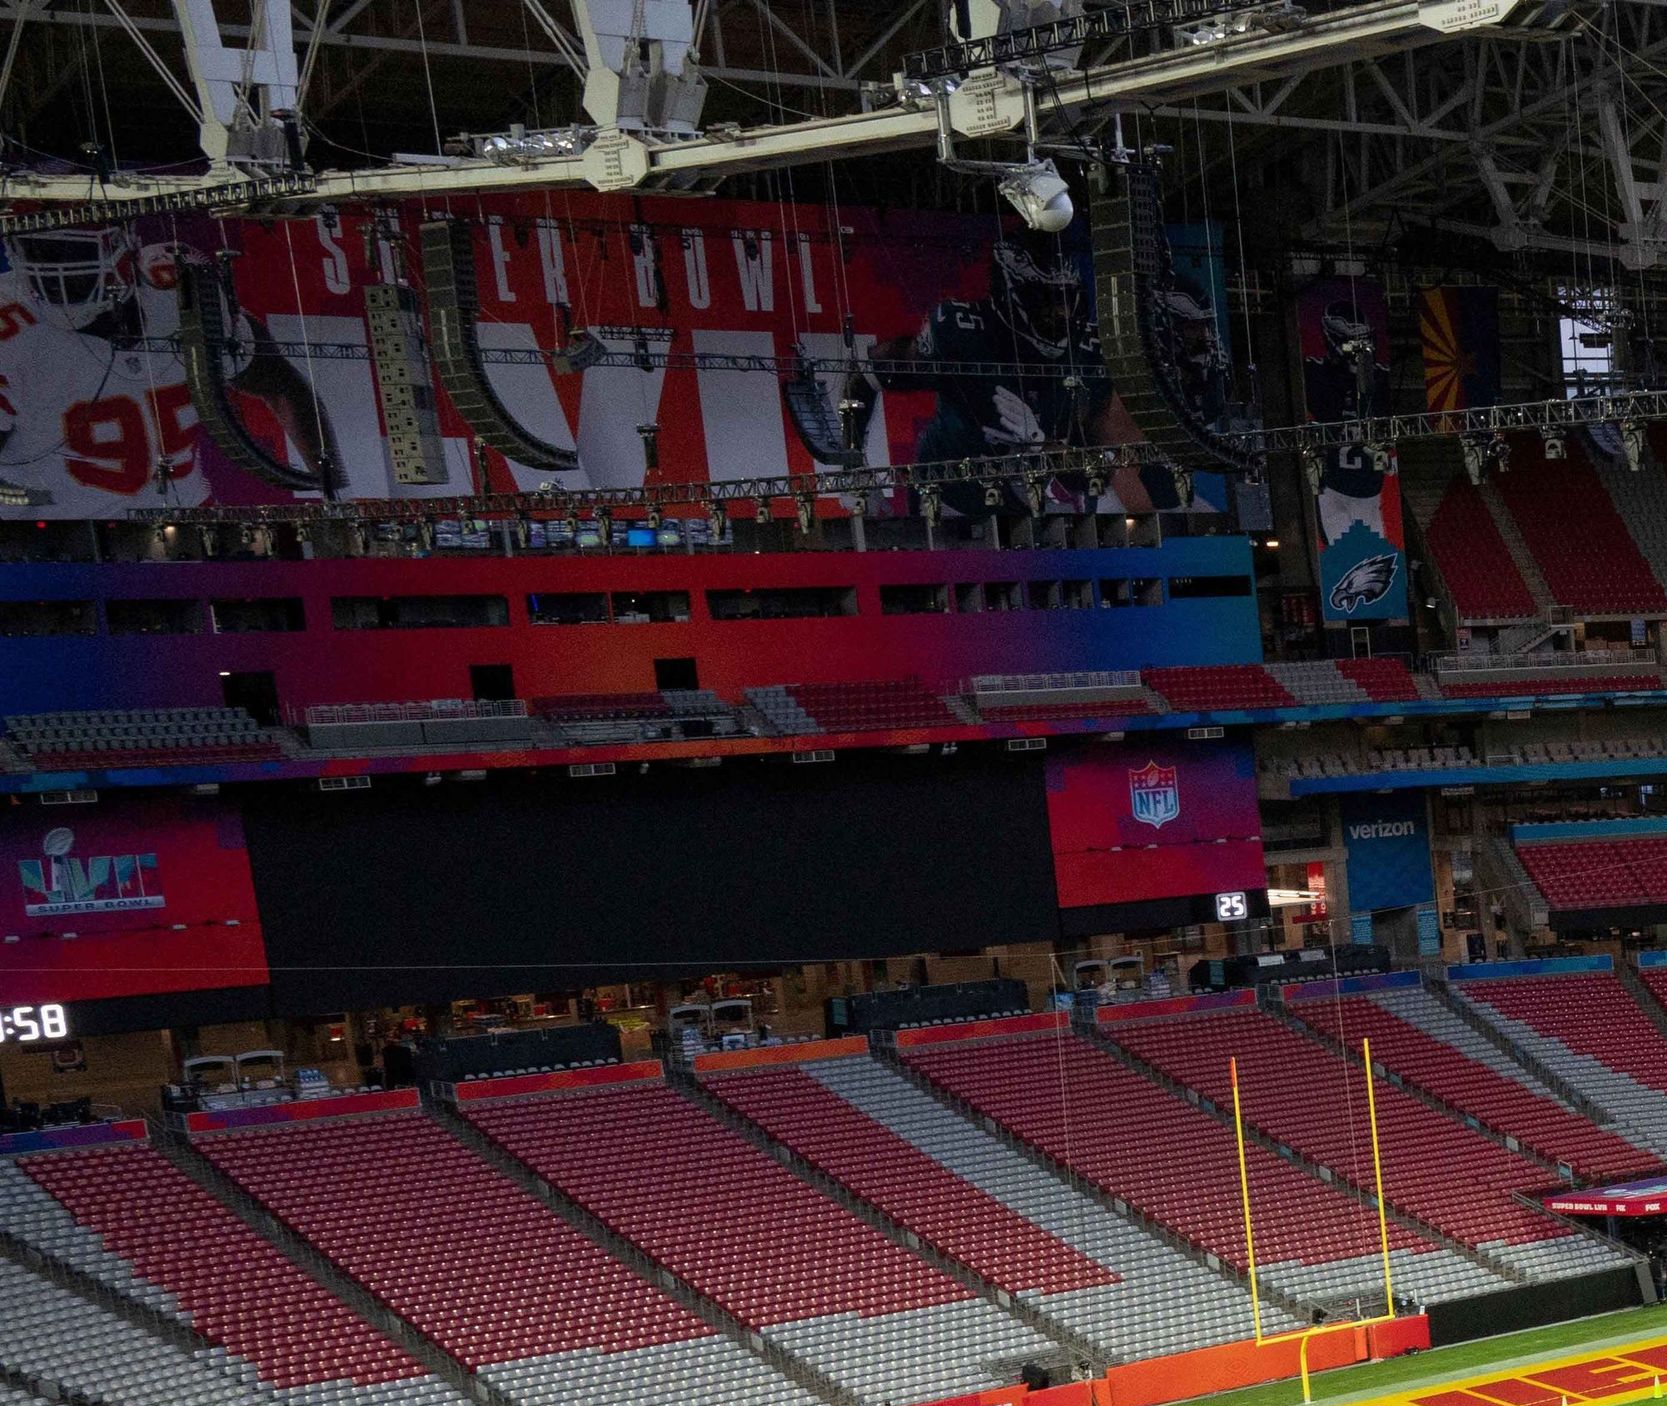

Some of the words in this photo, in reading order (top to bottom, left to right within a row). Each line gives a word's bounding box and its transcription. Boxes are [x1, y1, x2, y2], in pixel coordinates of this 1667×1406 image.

[628, 223, 823, 313] BOWL
[64, 383, 201, 496] 95
[1136, 790, 1176, 816] NFL
[1349, 820, 1416, 840] verizon
[37, 902, 96, 914] SUPER
[104, 896, 151, 909] BOWL
[1219, 895, 1244, 917] 25
[1552, 1202, 1575, 1210] SUPER
[1645, 1203, 1660, 1212] FOX
